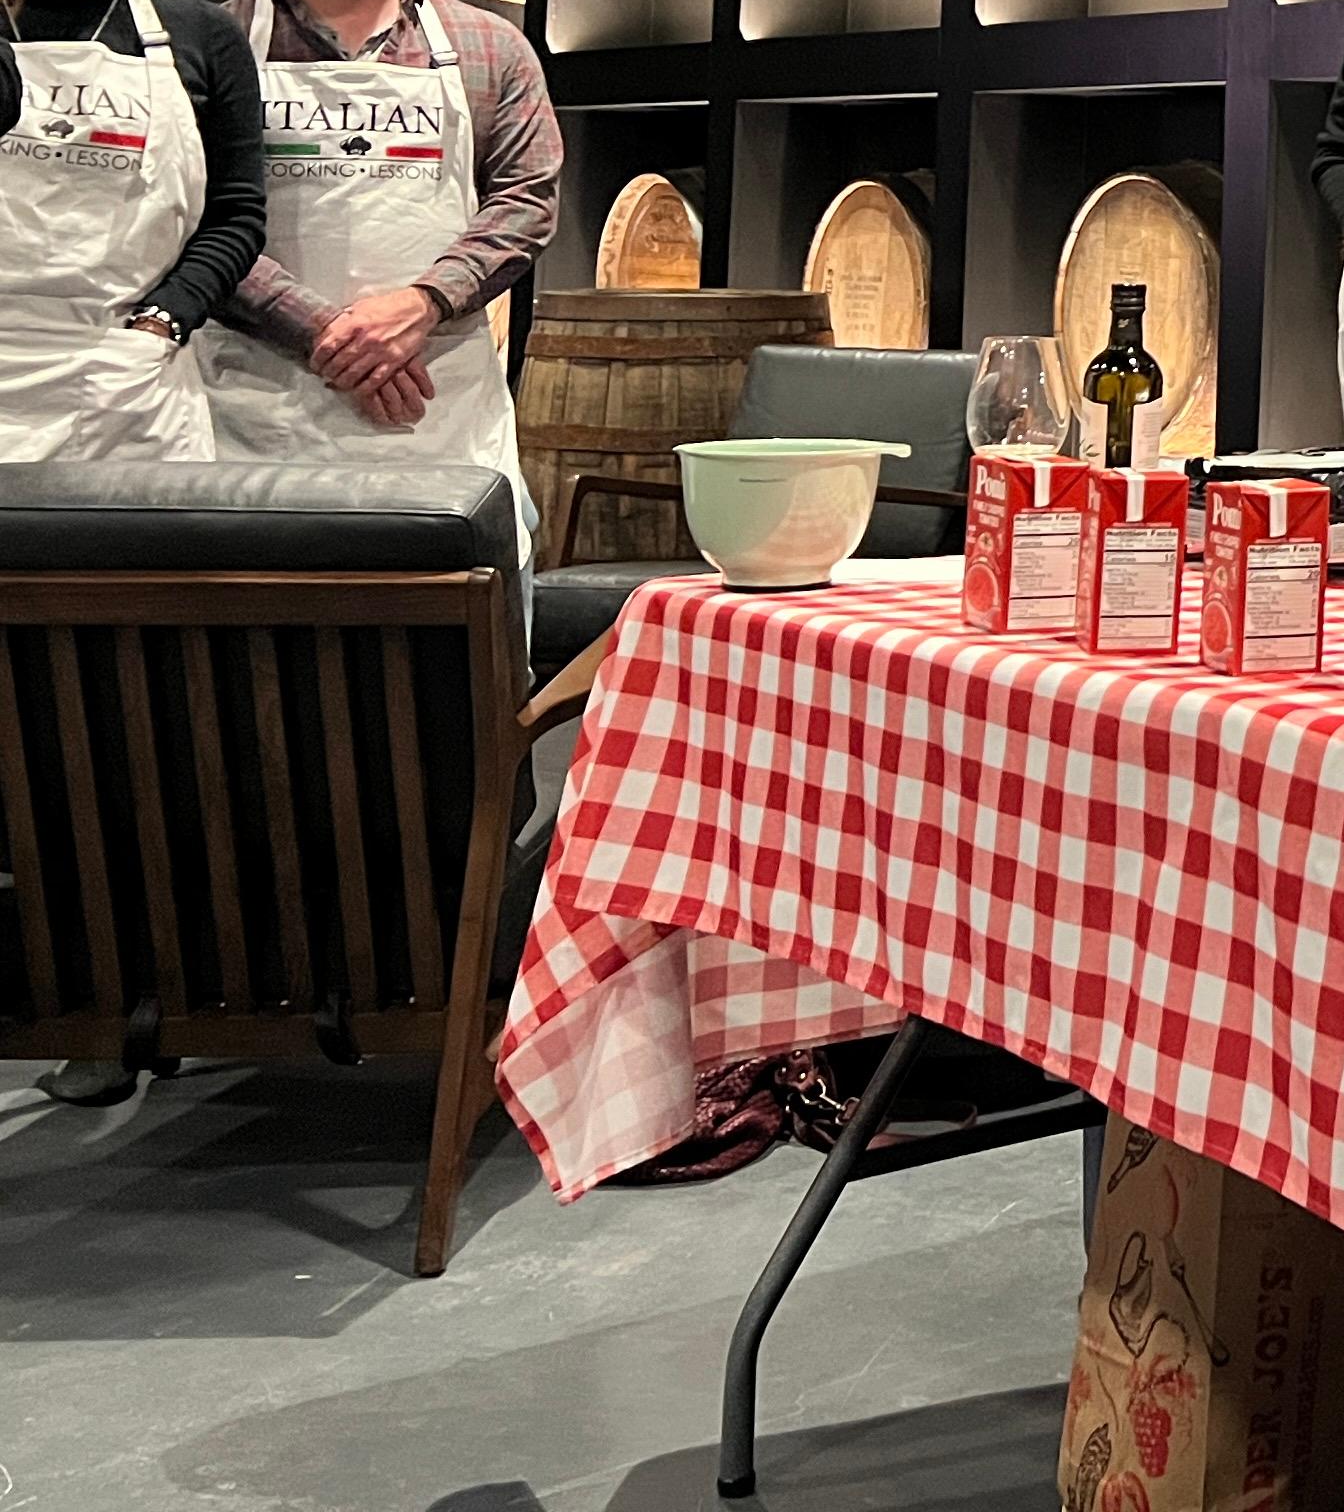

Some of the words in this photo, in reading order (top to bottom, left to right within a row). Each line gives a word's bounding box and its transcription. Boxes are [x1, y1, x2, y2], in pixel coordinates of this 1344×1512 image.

[260, 100, 443, 136] ITALIAN
[65, 149, 143, 172] LESSON
[369, 164, 443, 182] LESSONS
[1254, 1265, 1294, 1396] JOE'S
